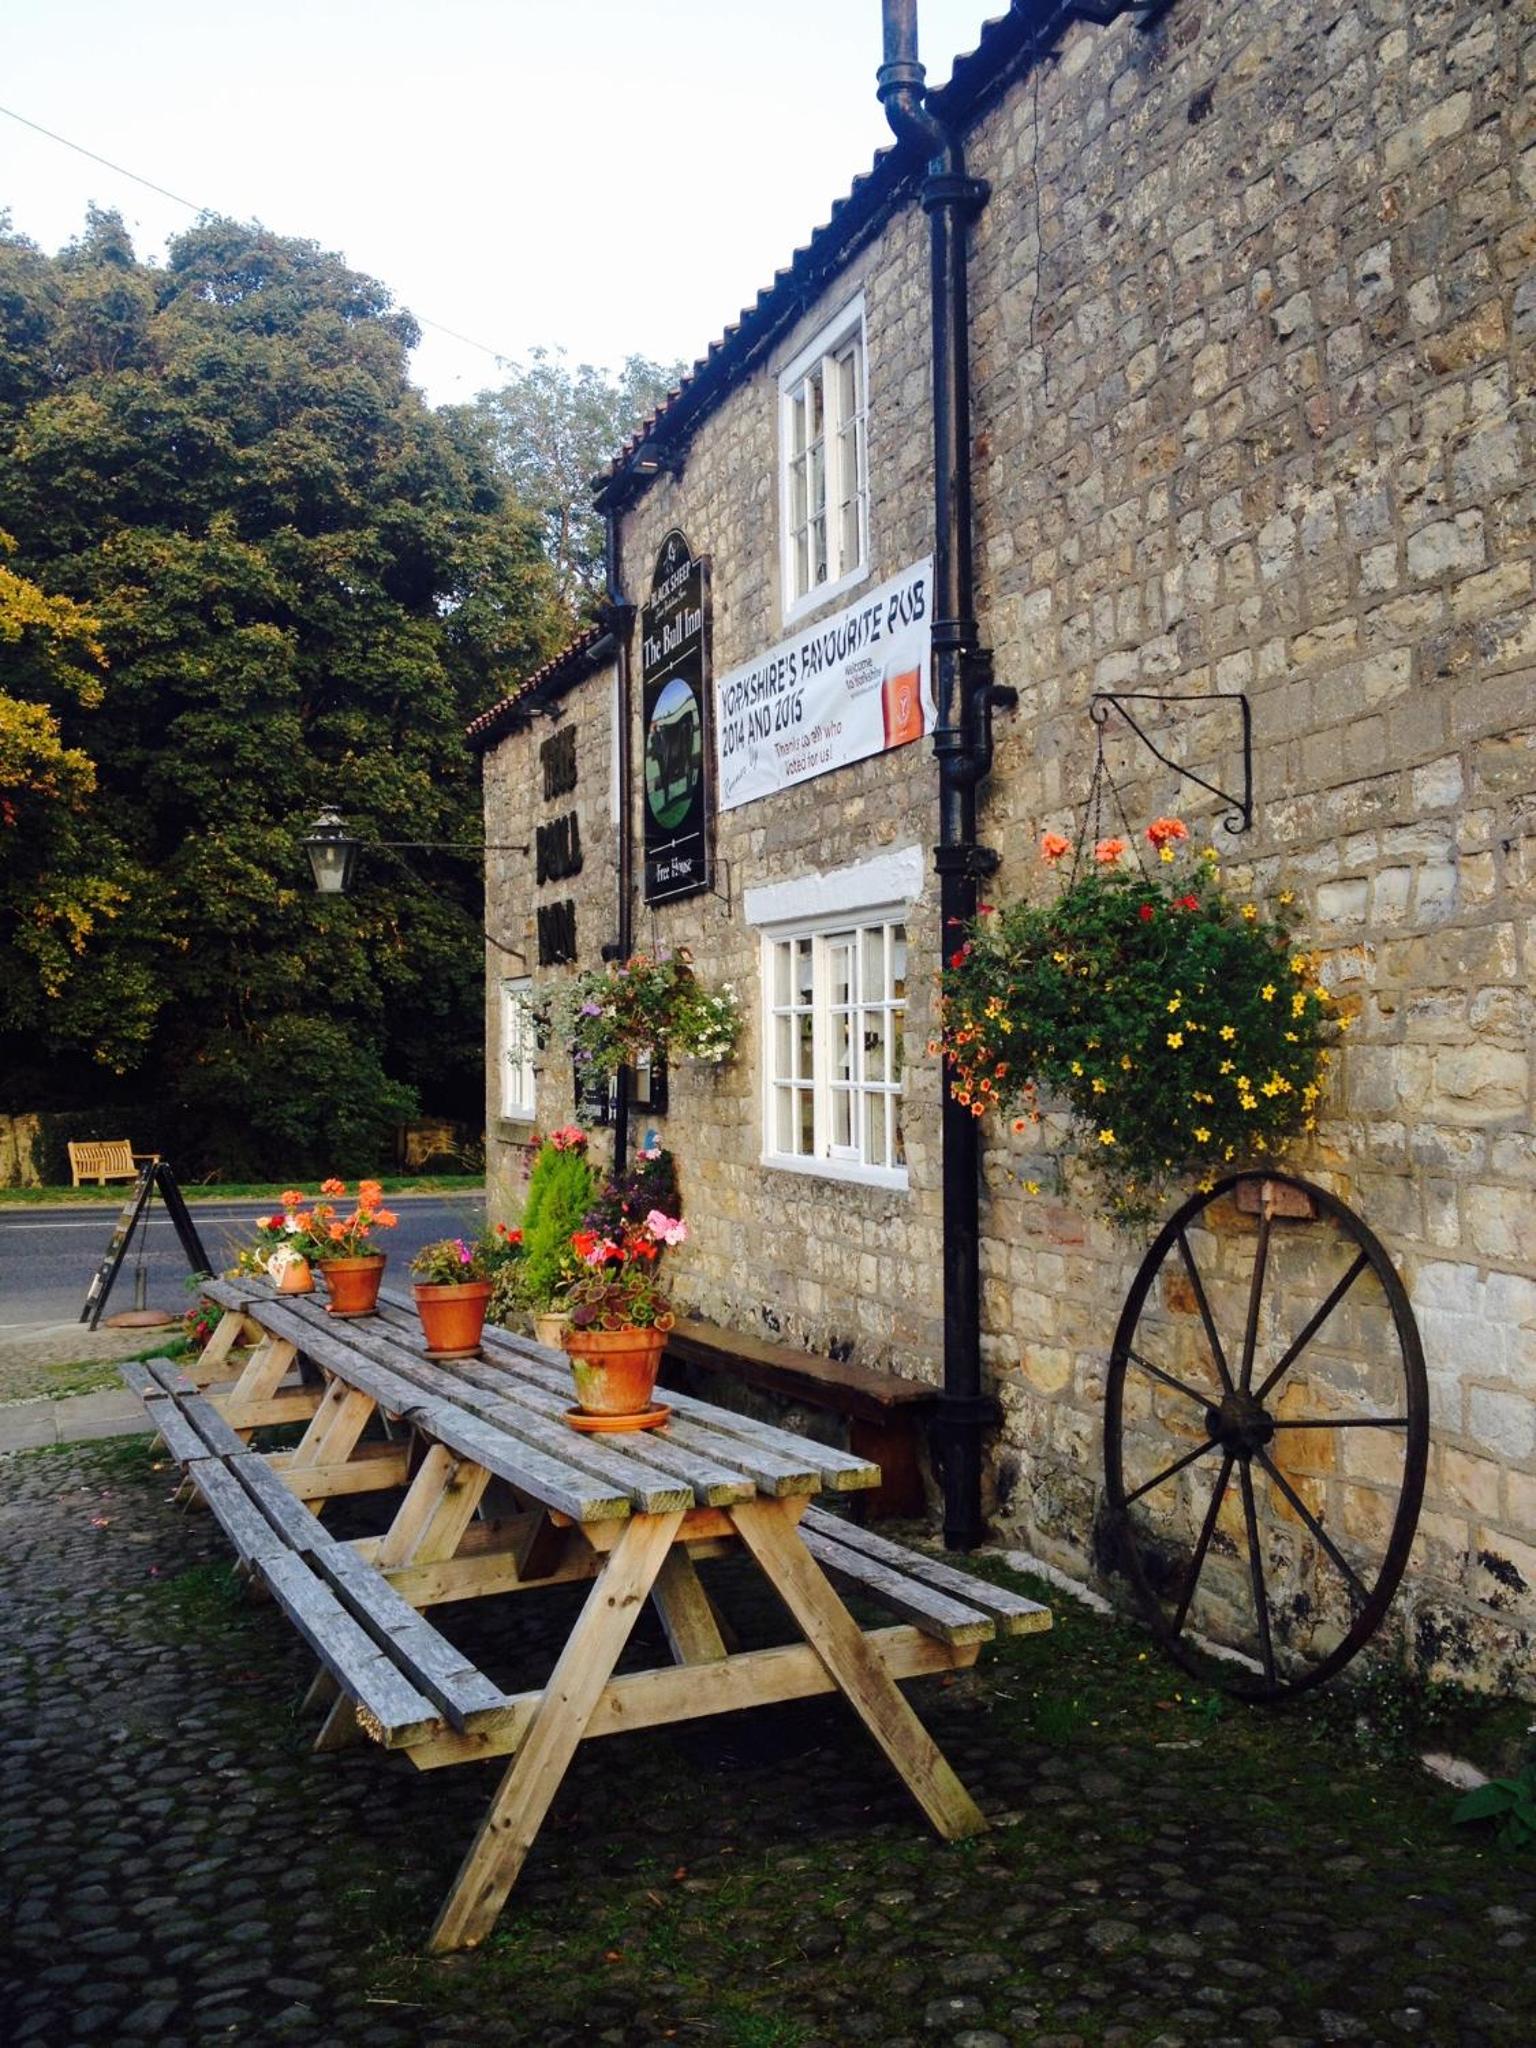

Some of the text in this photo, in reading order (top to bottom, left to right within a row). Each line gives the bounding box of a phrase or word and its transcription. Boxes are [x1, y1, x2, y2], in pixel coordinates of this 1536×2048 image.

[671, 560, 690, 591] SHEEP
[644, 607, 701, 669] The Bull Inn
[722, 579, 925, 720] YORKSHIRE'S FAVOURITE PUB
[722, 717, 744, 758] 2014
[748, 705, 770, 745] AND
[775, 687, 804, 732] 2015
[774, 737, 800, 758] Thanks
[801, 734, 810, 748] to
[823, 720, 842, 739] who
[807, 751, 818, 768] for
[656, 857, 692, 882] Free House
